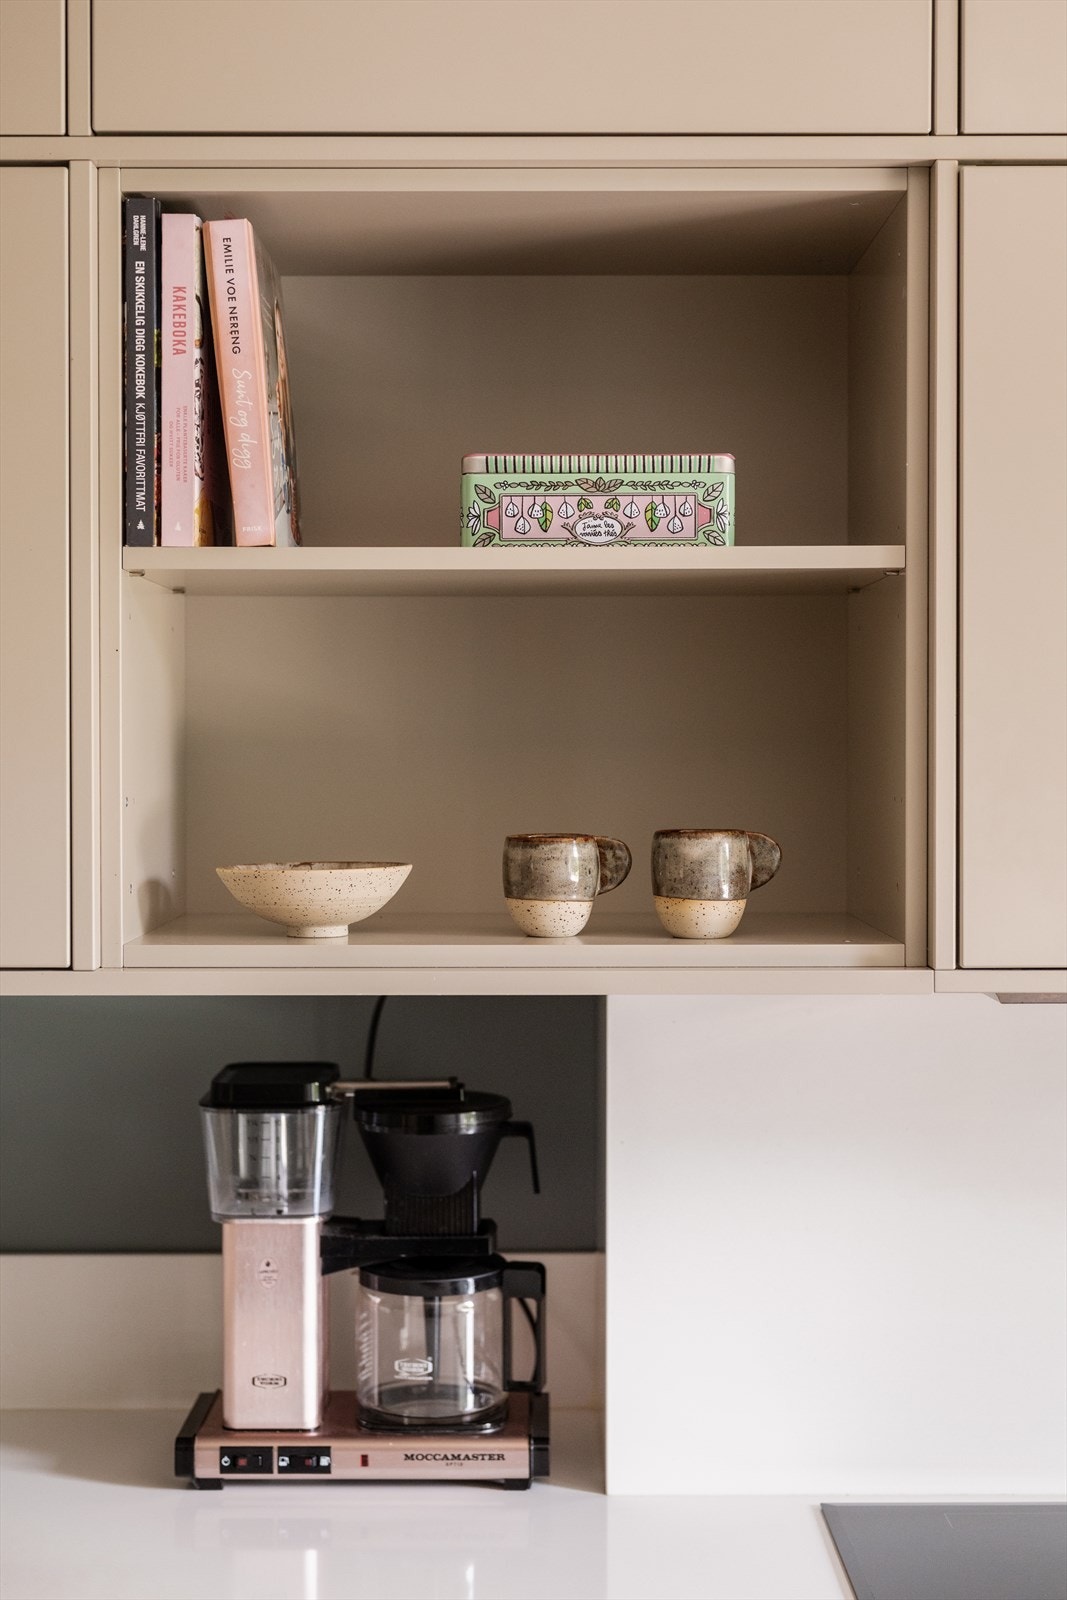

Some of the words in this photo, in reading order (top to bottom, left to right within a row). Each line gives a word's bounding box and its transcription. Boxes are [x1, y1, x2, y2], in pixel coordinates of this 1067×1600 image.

[135, 261, 145, 274] EN
[222, 237, 235, 274] EMILIE
[135, 275, 145, 326] SKIKKELIG
[226, 278, 237, 302] VOE
[135, 328, 145, 352] DIGG
[172, 286, 187, 356] KAKEBOKA
[228, 306, 241, 355] NERENG
[135, 354, 145, 399] KOKEBOK
[232, 368, 253, 407] Sunt
[135, 402, 146, 447] KJØTTFRI
[229, 410, 248, 428] og
[232, 434, 257, 470] digg
[135, 449, 146, 512] FAVORITTMAT
[404, 1453, 506, 1461] MOCCAMASTER
